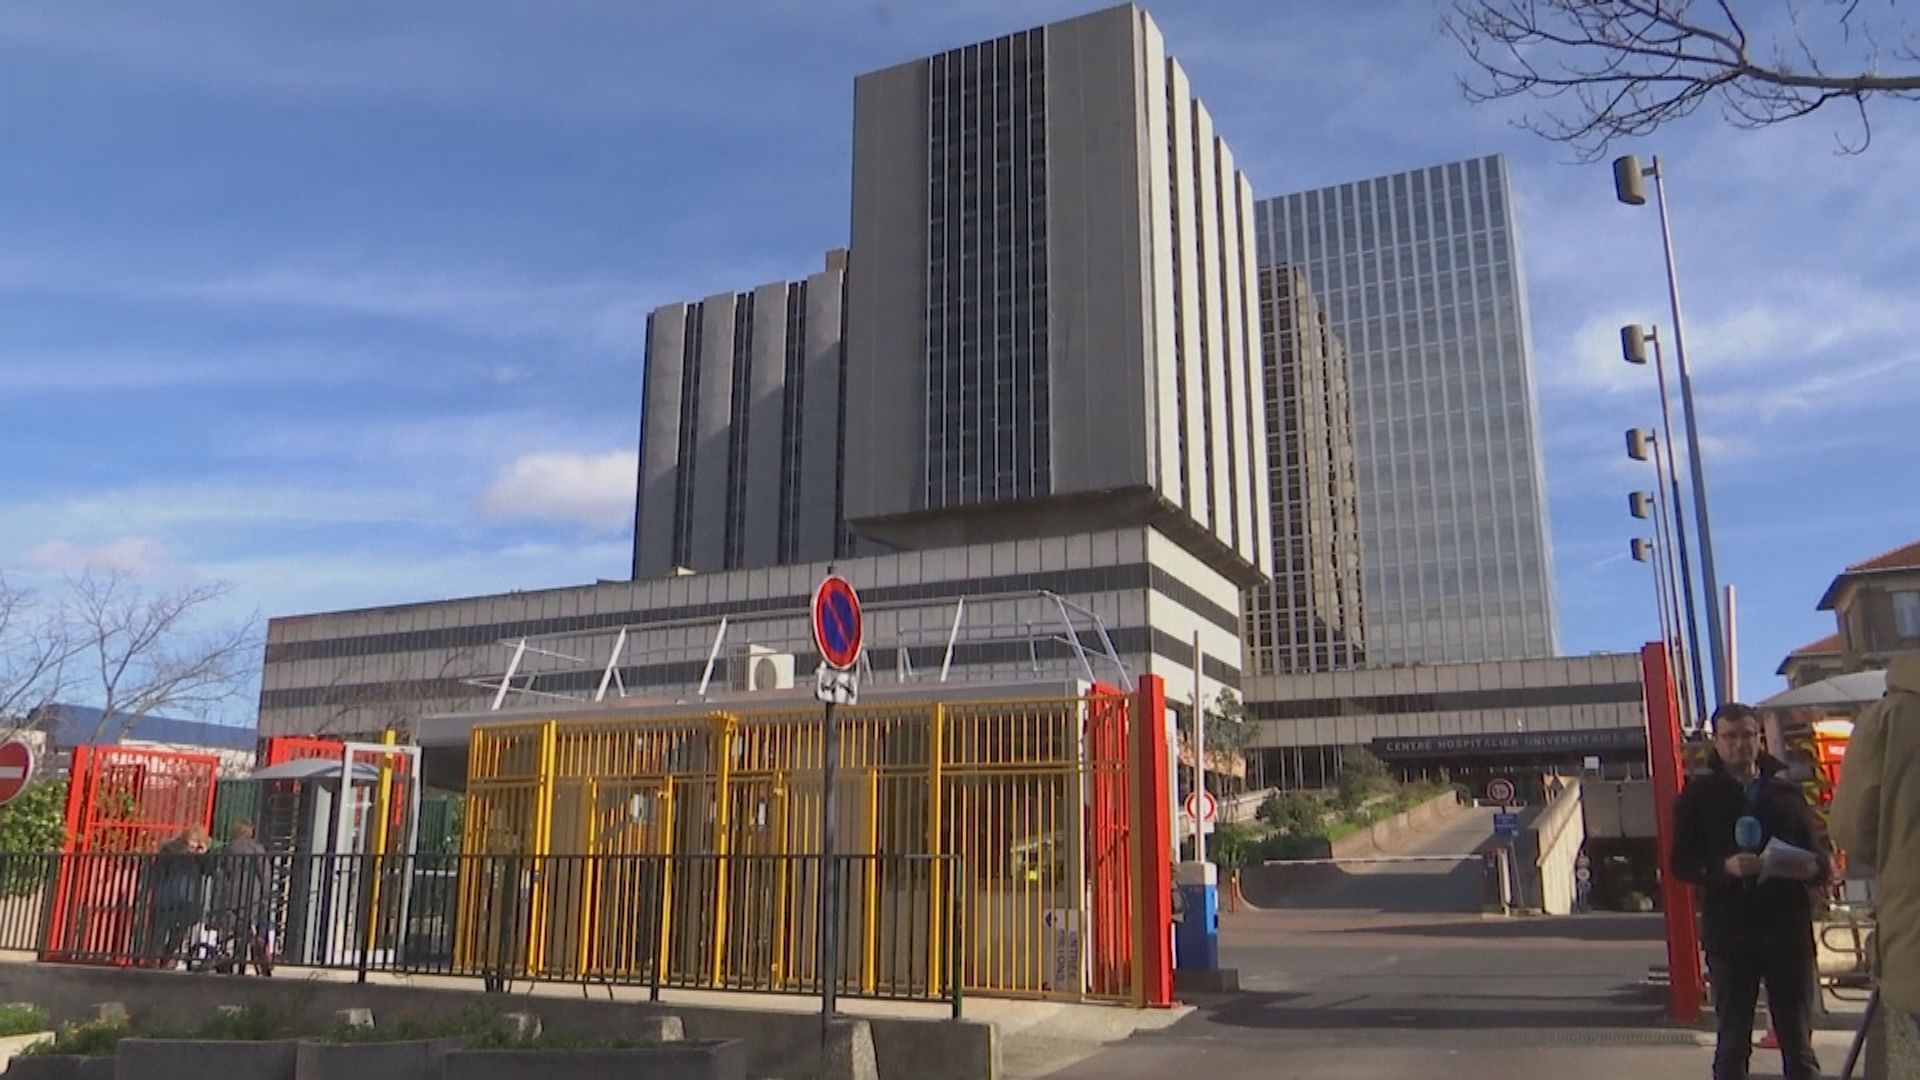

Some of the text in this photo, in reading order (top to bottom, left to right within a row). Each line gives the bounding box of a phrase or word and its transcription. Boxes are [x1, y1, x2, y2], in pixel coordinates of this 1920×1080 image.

[1386, 741, 1431, 752] CENTRE
[1438, 736, 1518, 749] HOSPITALIER
[1525, 734, 1618, 746] UNIVERSITAIRE
